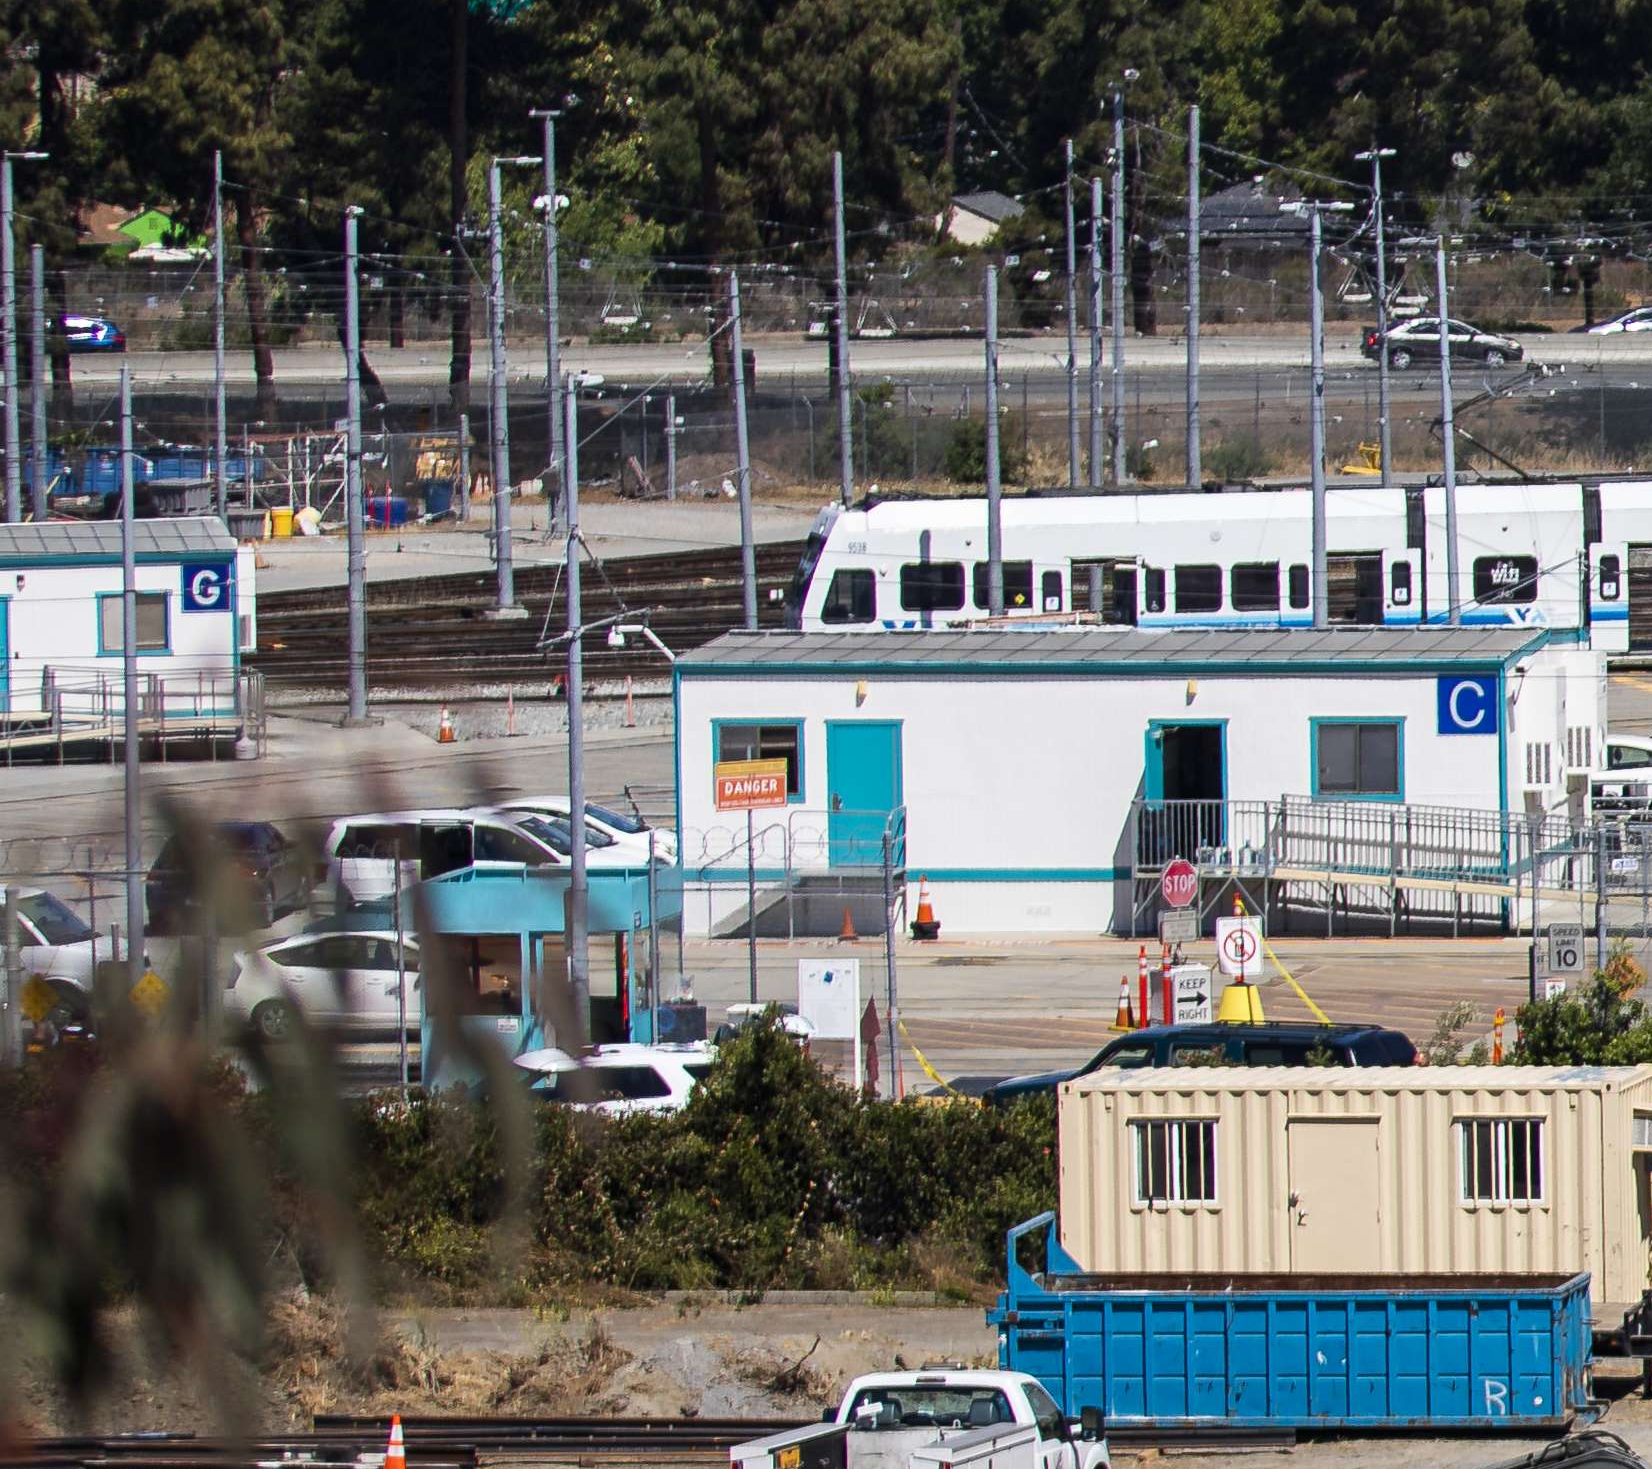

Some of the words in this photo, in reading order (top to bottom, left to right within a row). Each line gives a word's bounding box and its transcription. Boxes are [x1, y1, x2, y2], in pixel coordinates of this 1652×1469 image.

[192, 570, 220, 605] G
[1449, 680, 1485, 728] C
[724, 779, 778, 795] DANGER
[1165, 874, 1196, 893] STOP
[1553, 927, 1579, 937] SPEED
[1556, 949, 1577, 967] 10
[1179, 978, 1206, 989] KEEP
[1178, 1008, 1208, 1020] RIGHT
[1485, 1379, 1507, 1416] R
